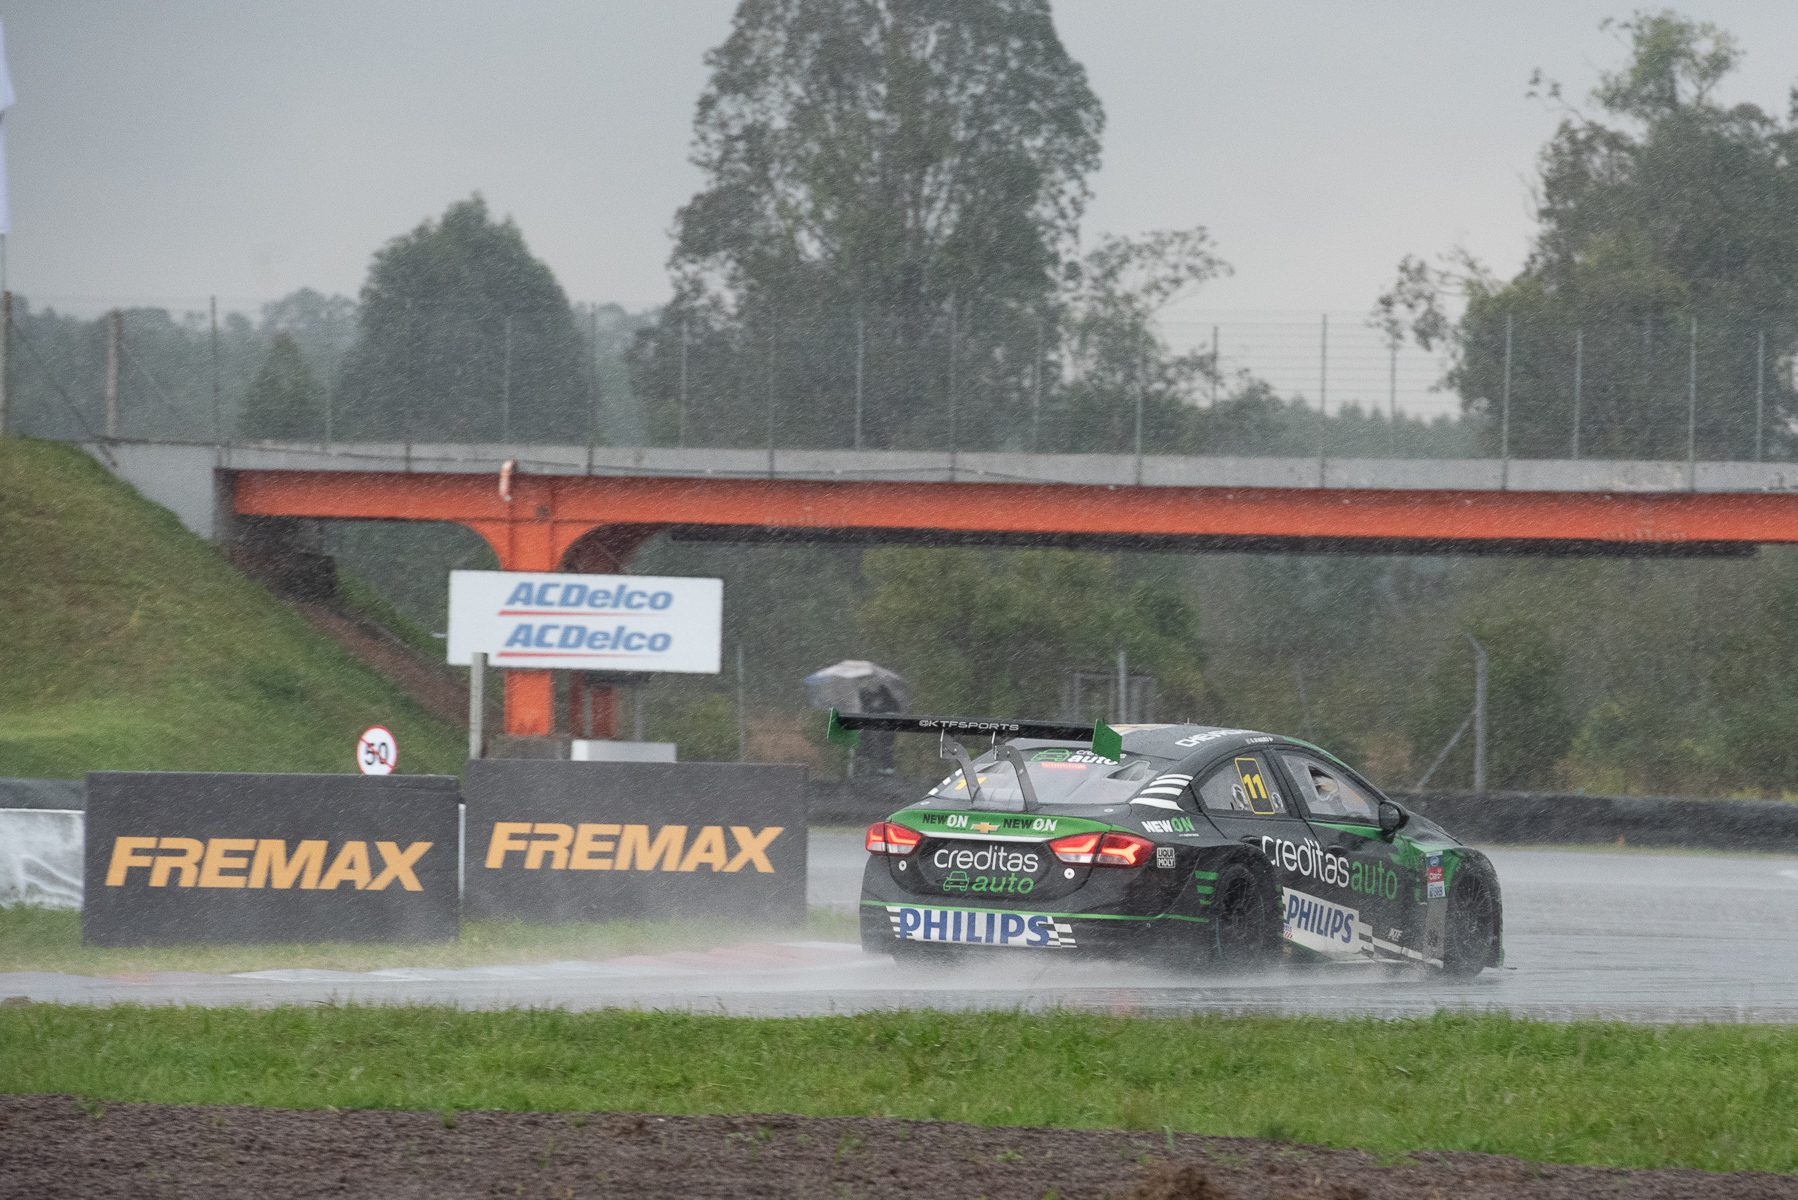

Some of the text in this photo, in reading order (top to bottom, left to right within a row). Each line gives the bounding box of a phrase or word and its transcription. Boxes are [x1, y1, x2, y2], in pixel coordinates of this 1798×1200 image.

[504, 581, 673, 610] ACDelco
[504, 623, 673, 652] ACDelco
[364, 742, 389, 766] 50
[1243, 774, 1267, 799] 11
[484, 821, 786, 874] FREMAX
[933, 845, 1039, 873] creditas
[104, 836, 434, 892] FREMAX
[1158, 858, 1175, 867] MOLY
[971, 873, 1034, 894] auto
[1350, 861, 1398, 900] auto
[900, 907, 1052, 947] PHILIPS
[1286, 894, 1355, 943] PHILIPS
